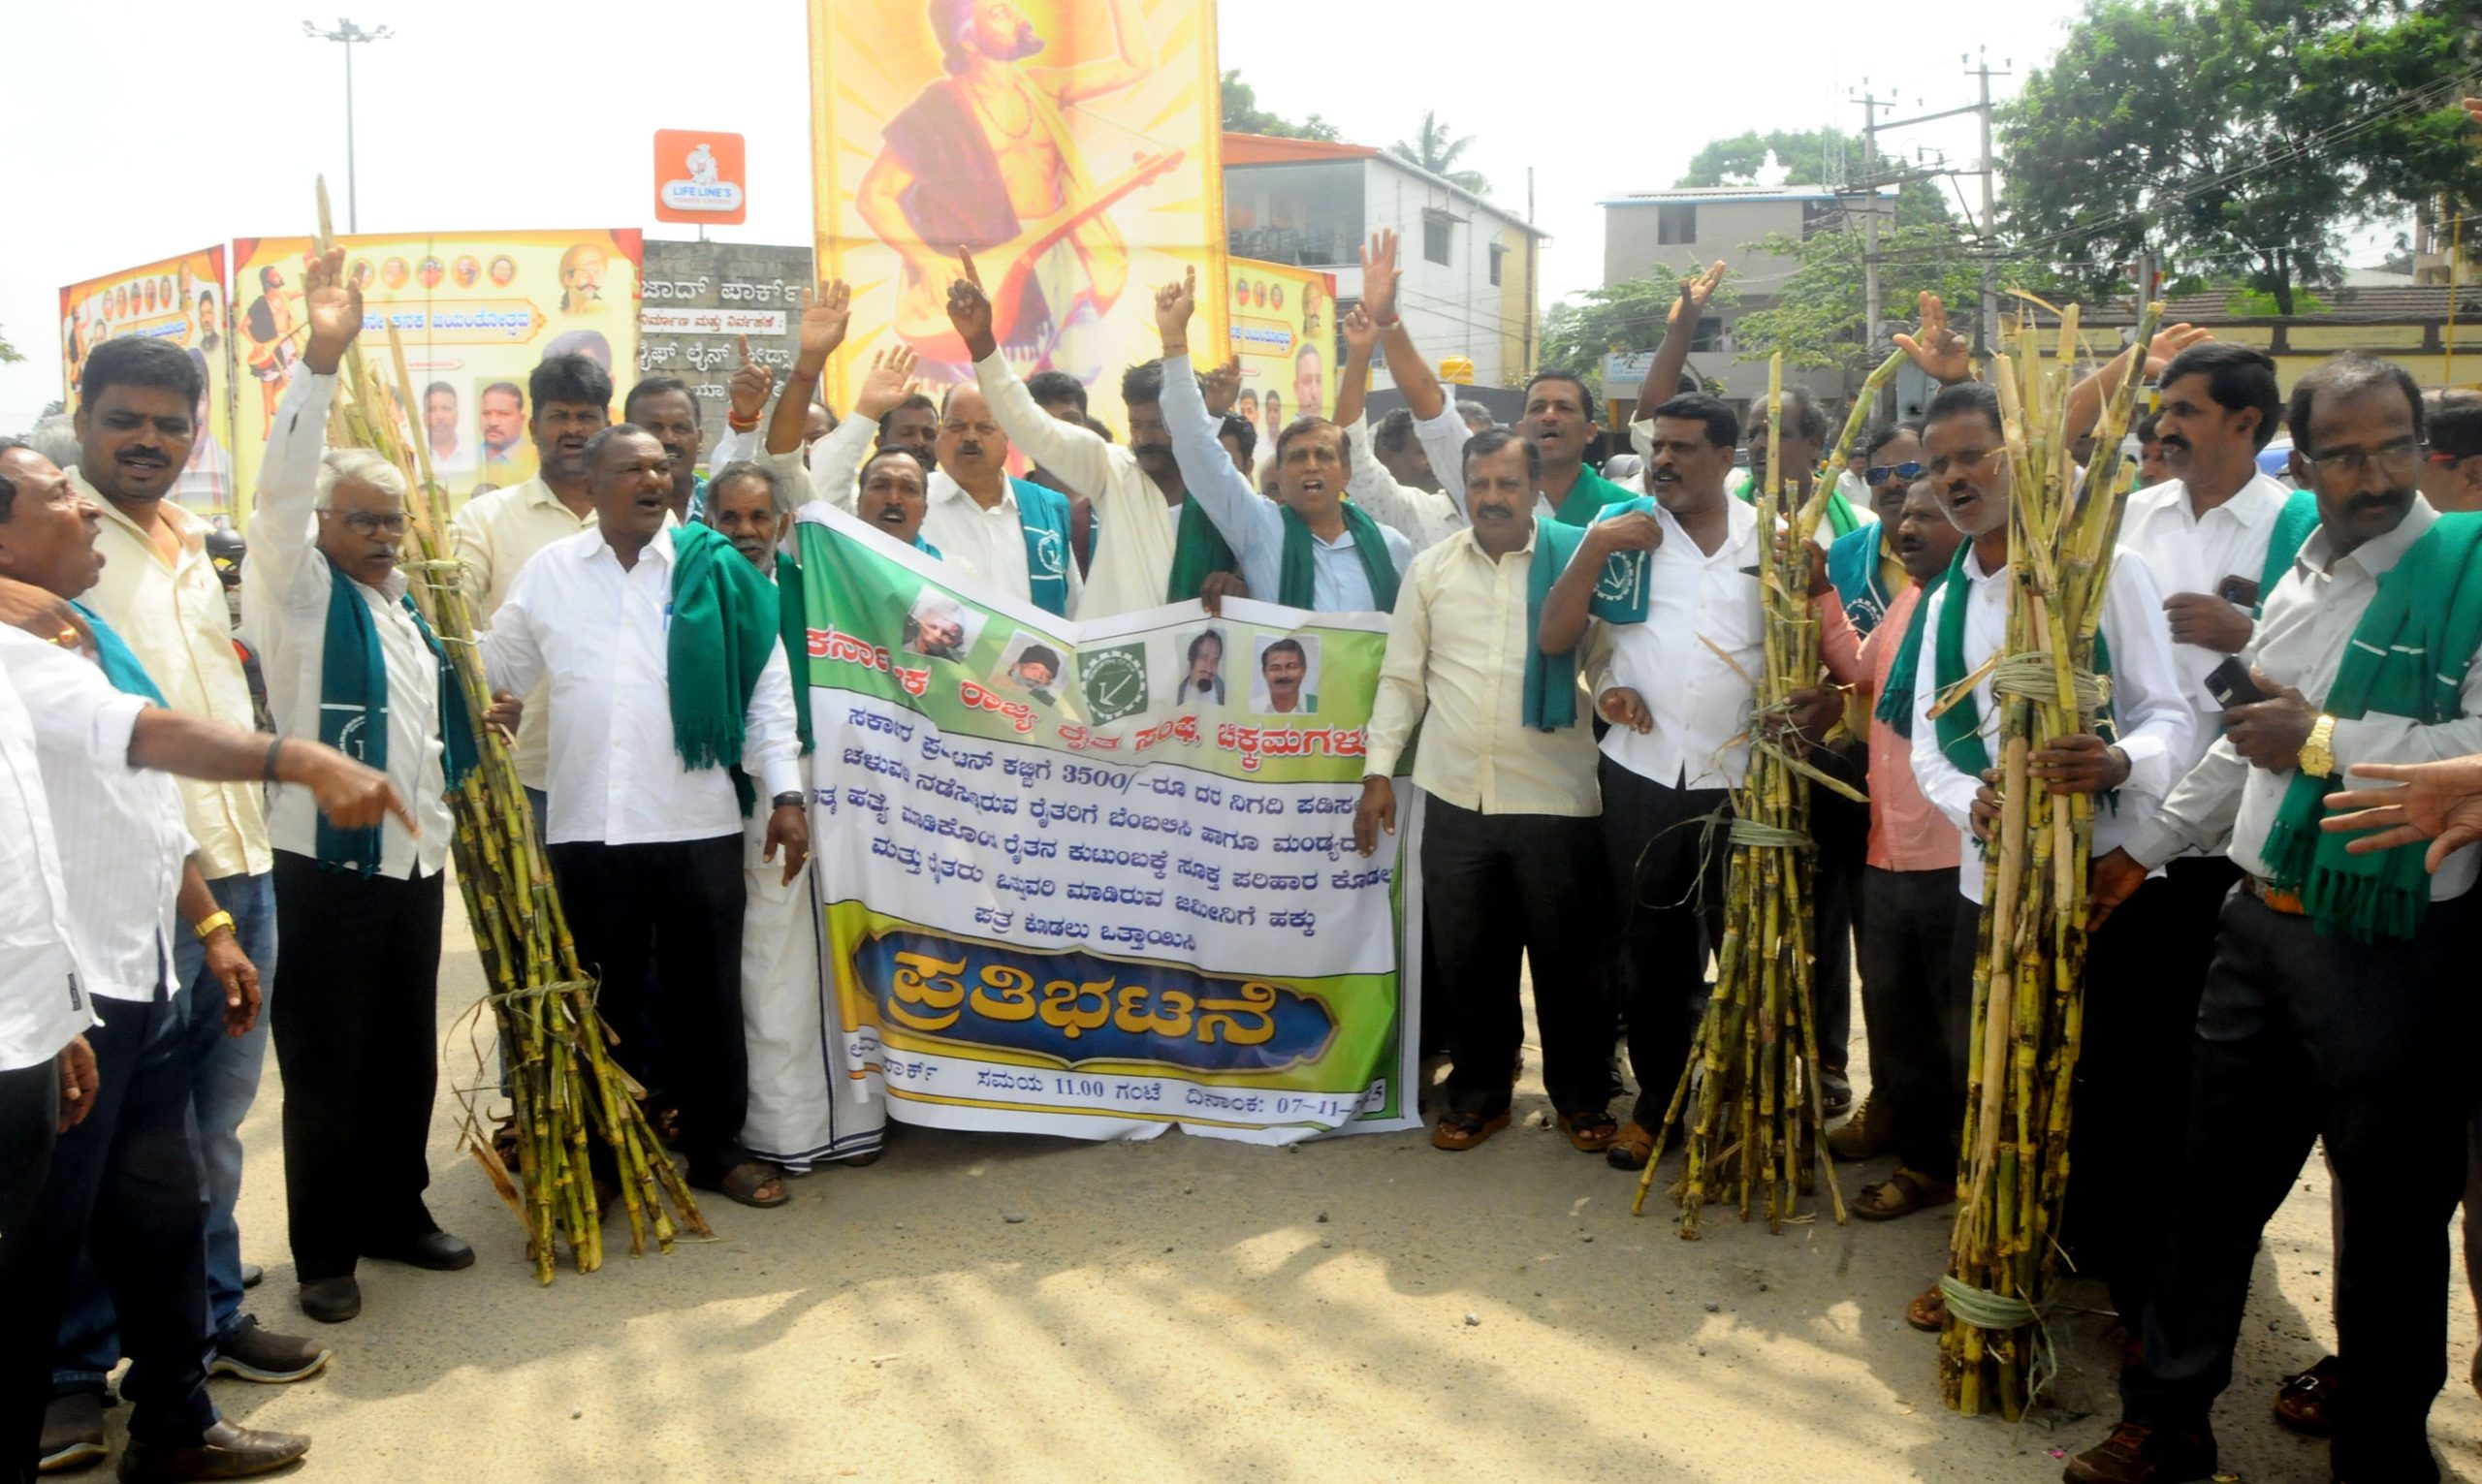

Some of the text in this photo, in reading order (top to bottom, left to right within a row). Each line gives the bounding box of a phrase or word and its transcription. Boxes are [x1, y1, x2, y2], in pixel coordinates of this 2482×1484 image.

[673, 186, 732, 198] LIFE LINE'S
[641, 275, 710, 300] ಜಾದ್
[960, 680, 1038, 734] ರಾಜ್ಯ
[1194, 784, 1222, 806] ದರ
[1228, 794, 1284, 815] ನಿಗದಿ
[1030, 797, 1098, 829] ರೈತರಿಗೆ
[1108, 805, 1193, 837] ಬೆಂಬಲಿಸಿ
[1201, 826, 1259, 852] ಹಾಗೂ
[1003, 834, 1058, 865] ರೈತನ
[1068, 841, 1168, 880] ಕುಟುಂಬಕ್ಕೆ
[1232, 868, 1320, 891] ಪರಿಹಾರ
[1066, 880, 1164, 908] ಮಾಡಿರುವ
[974, 904, 1014, 934] ಪತ್ರ
[886, 950, 1277, 1045] ಪ್ರತಿಭಟನೆ
[976, 1067, 1044, 1092] ಸಮಯ
[1055, 1077, 1104, 1098] 11.00
[1115, 1081, 1162, 1102] ಗಂಟೆ
